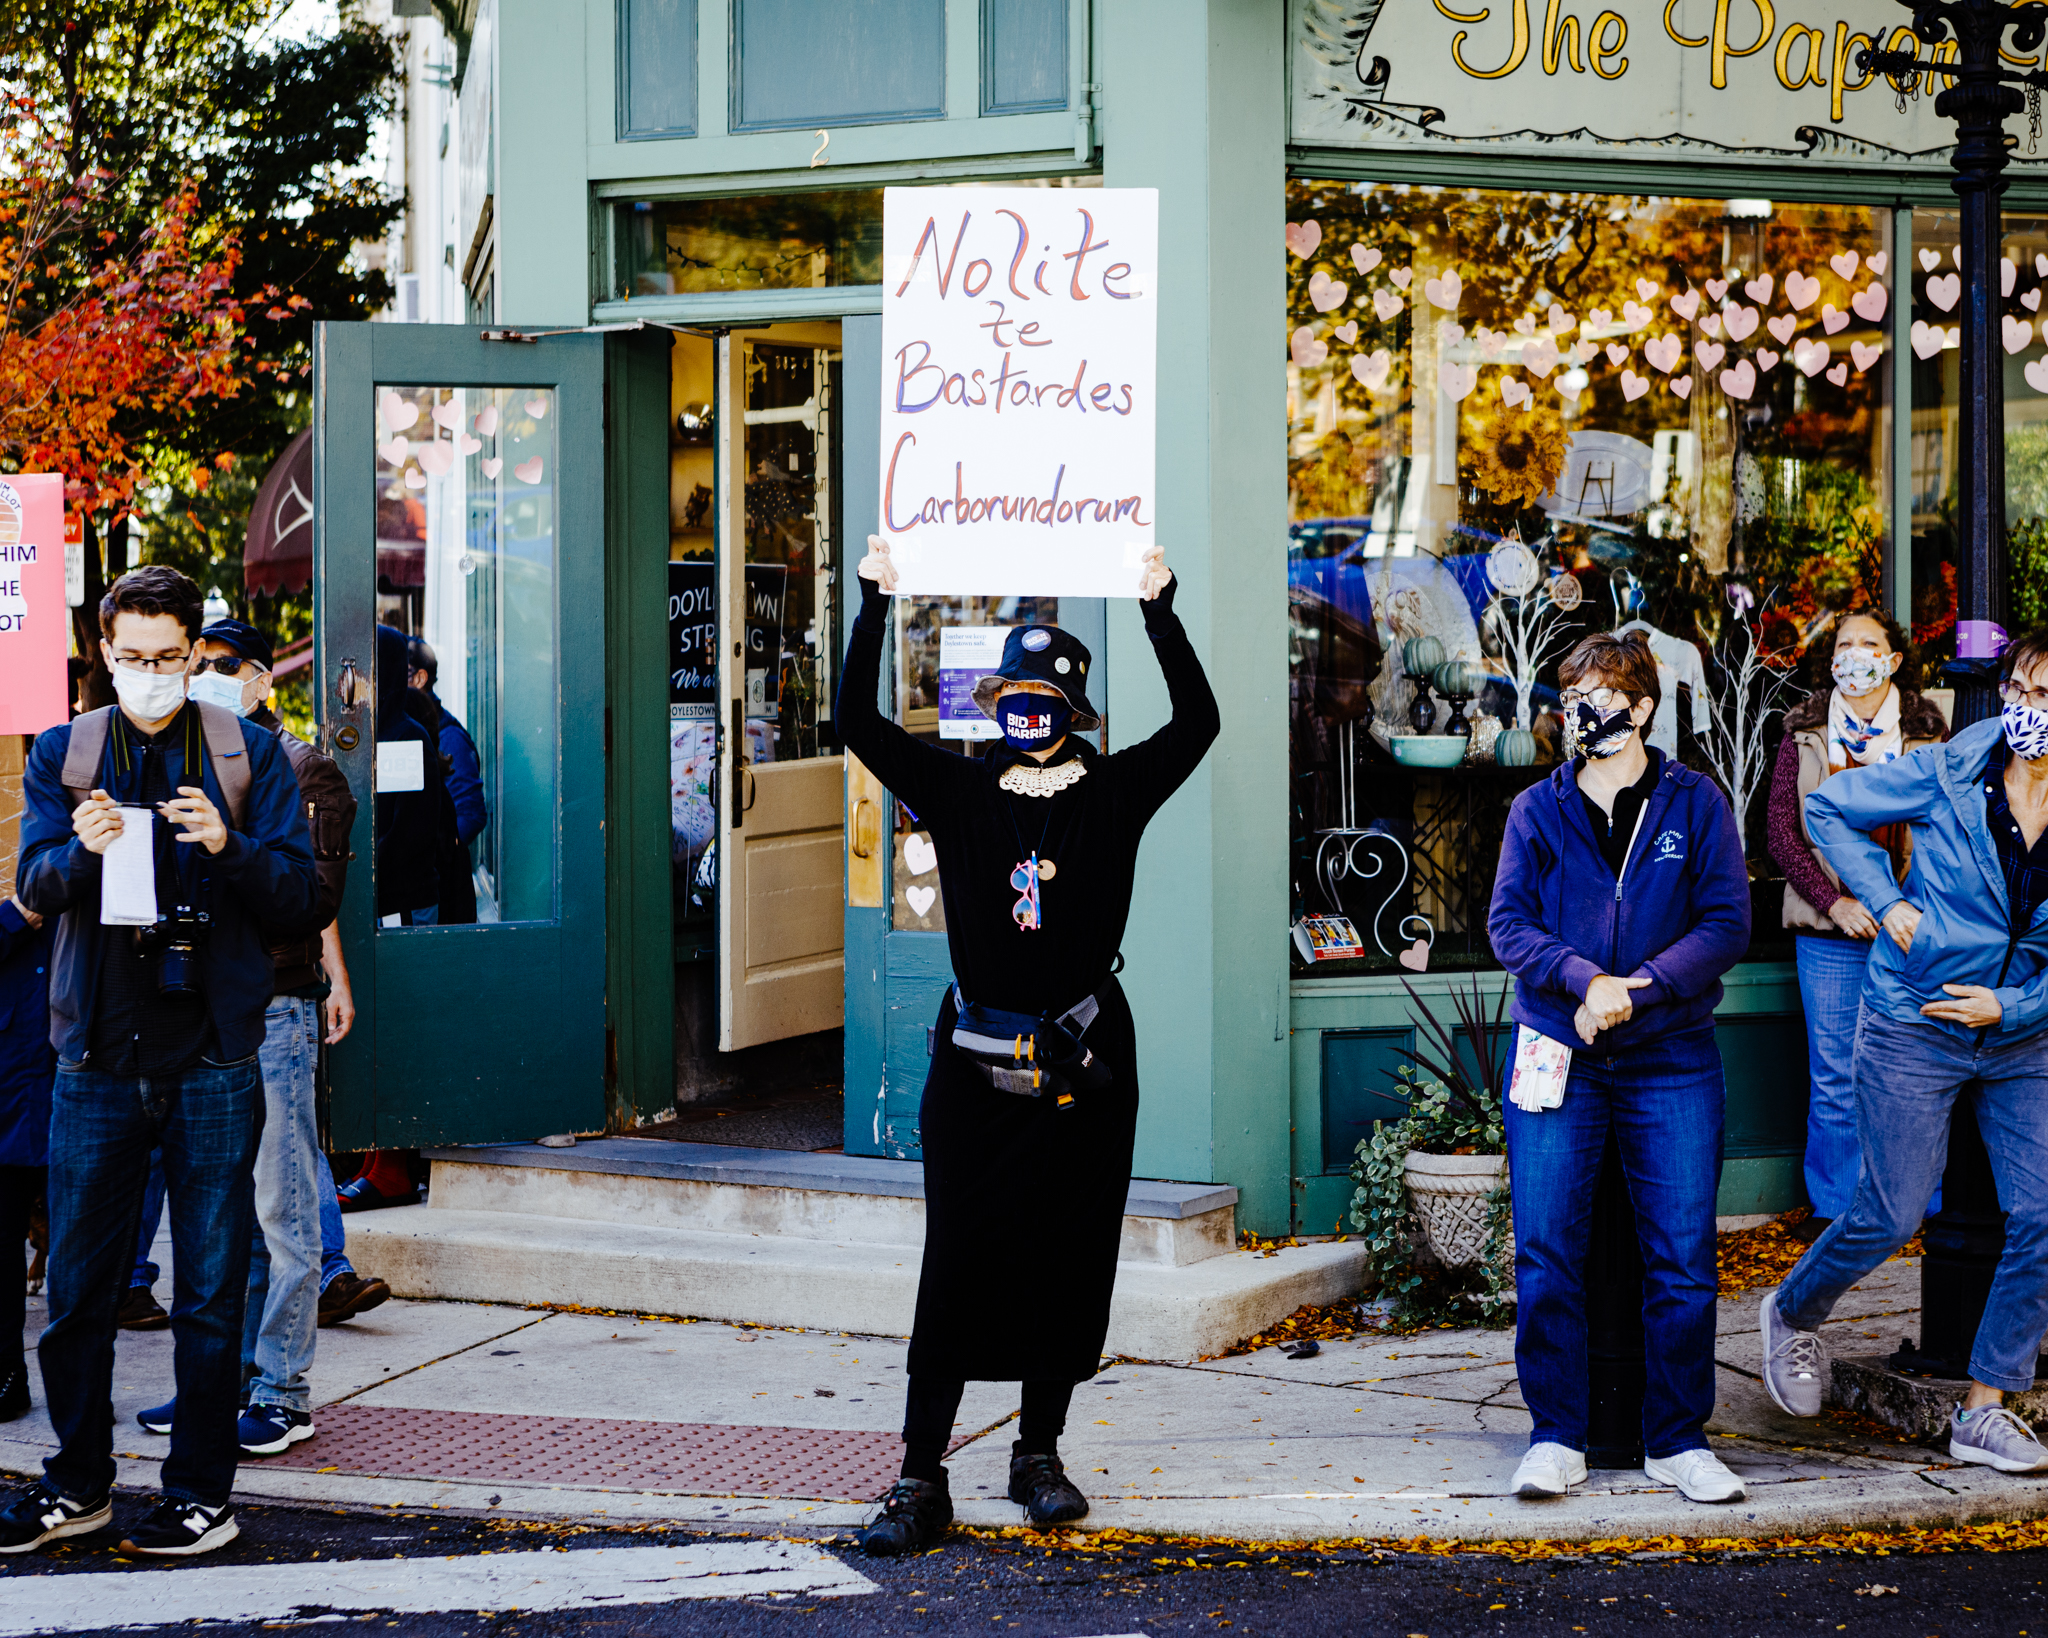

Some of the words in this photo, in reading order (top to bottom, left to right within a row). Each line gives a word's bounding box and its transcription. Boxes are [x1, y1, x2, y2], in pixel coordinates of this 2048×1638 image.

[1434, 0, 1629, 80] The
[811, 129, 829, 168] 2
[896, 207, 1142, 300] Nolite
[979, 300, 1053, 348] te
[892, 340, 1133, 415] Bastardes
[884, 431, 1152, 533] Carborundorum
[669, 586, 778, 622] DOYLWN
[671, 666, 701, 690] We
[1007, 713, 1051, 728] BIDEN
[1007, 727, 1051, 739] HARRIS
[1668, 830, 1684, 839] MAY
